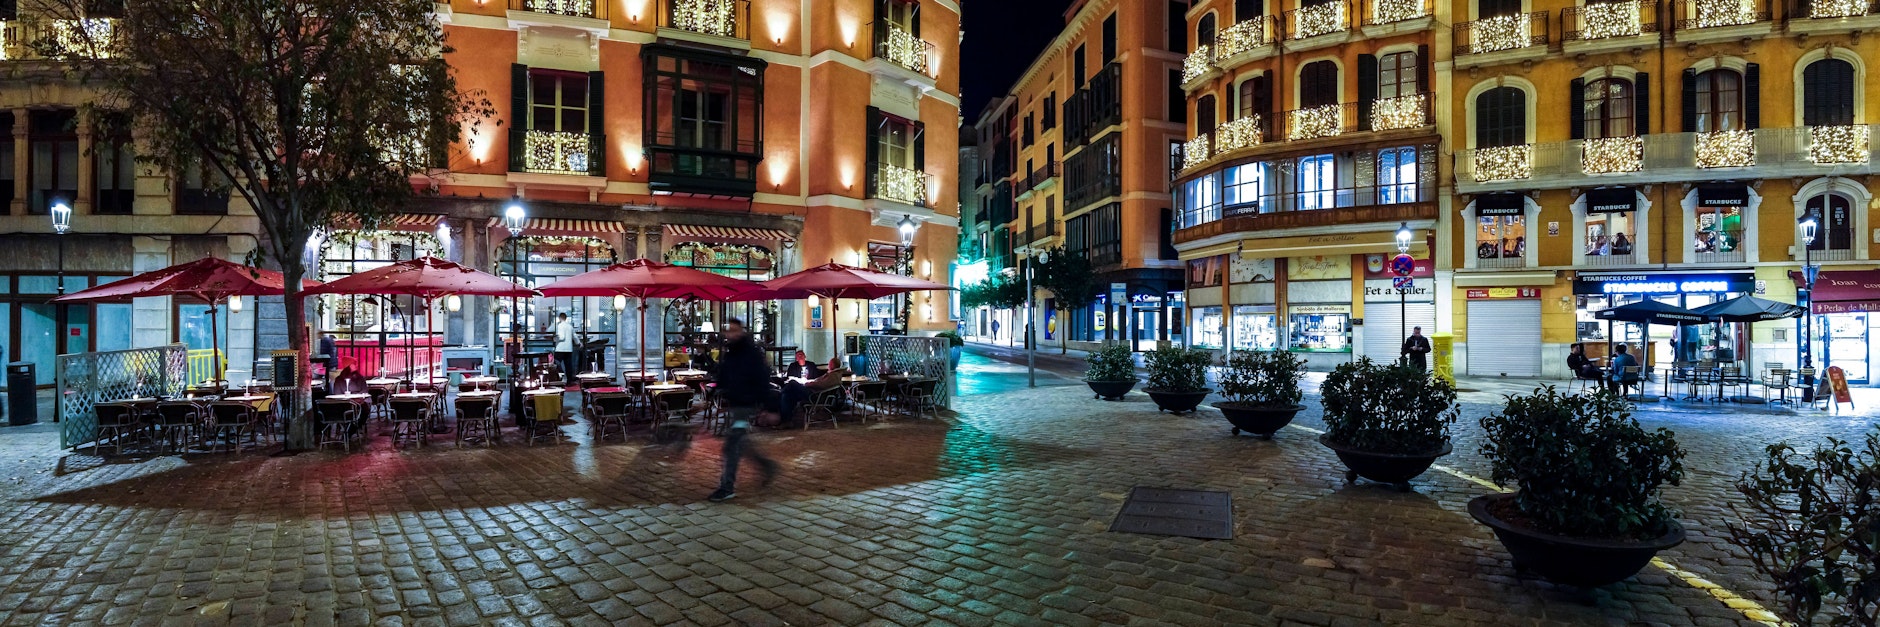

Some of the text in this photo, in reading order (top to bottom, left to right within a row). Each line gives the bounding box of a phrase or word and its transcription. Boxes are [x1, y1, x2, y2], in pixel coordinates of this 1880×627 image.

[1365, 286, 1381, 295] Fet
[1603, 281, 1728, 293] STARBUCKS COFFEE
[1824, 304, 1846, 312] Perlas
[1847, 303, 1857, 311] de
